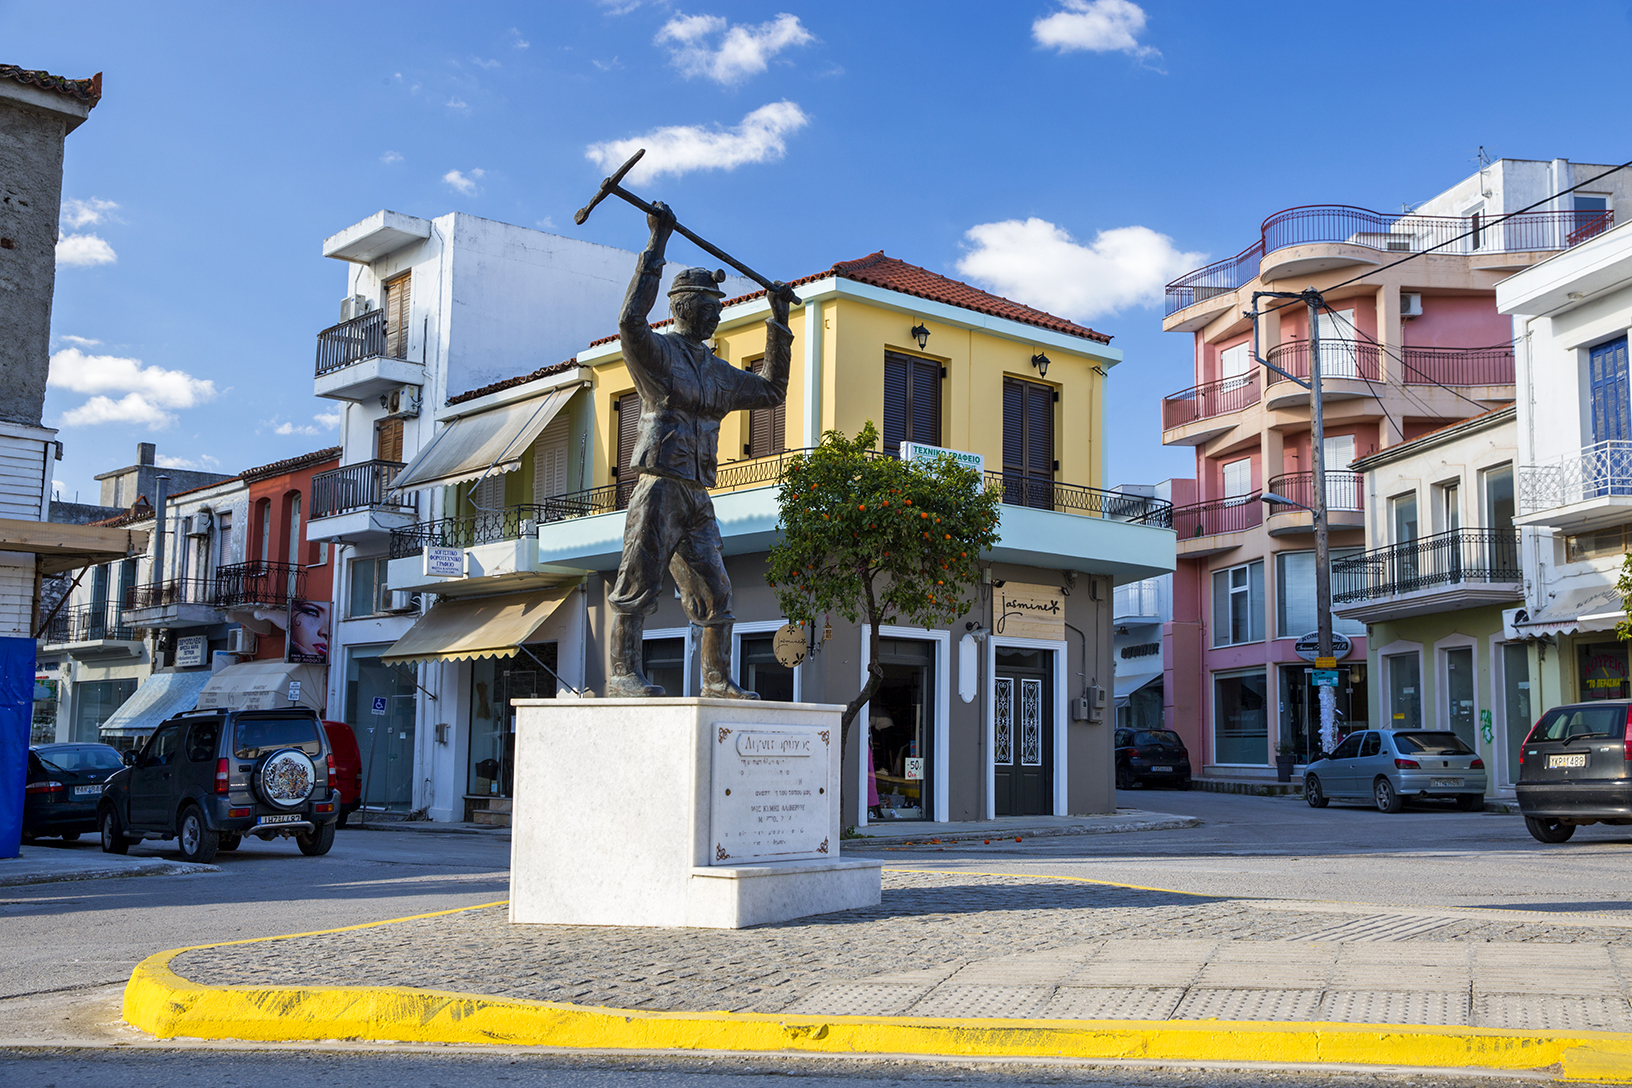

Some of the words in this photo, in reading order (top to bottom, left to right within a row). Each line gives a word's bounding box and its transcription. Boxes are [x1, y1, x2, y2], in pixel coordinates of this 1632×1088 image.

[913, 446, 947, 457] ΤΕΧΝΙΚΟ
[997, 591, 1054, 634] jasmine
[1584, 654, 1626, 678] ΚΟΥΡΕΙΟ
